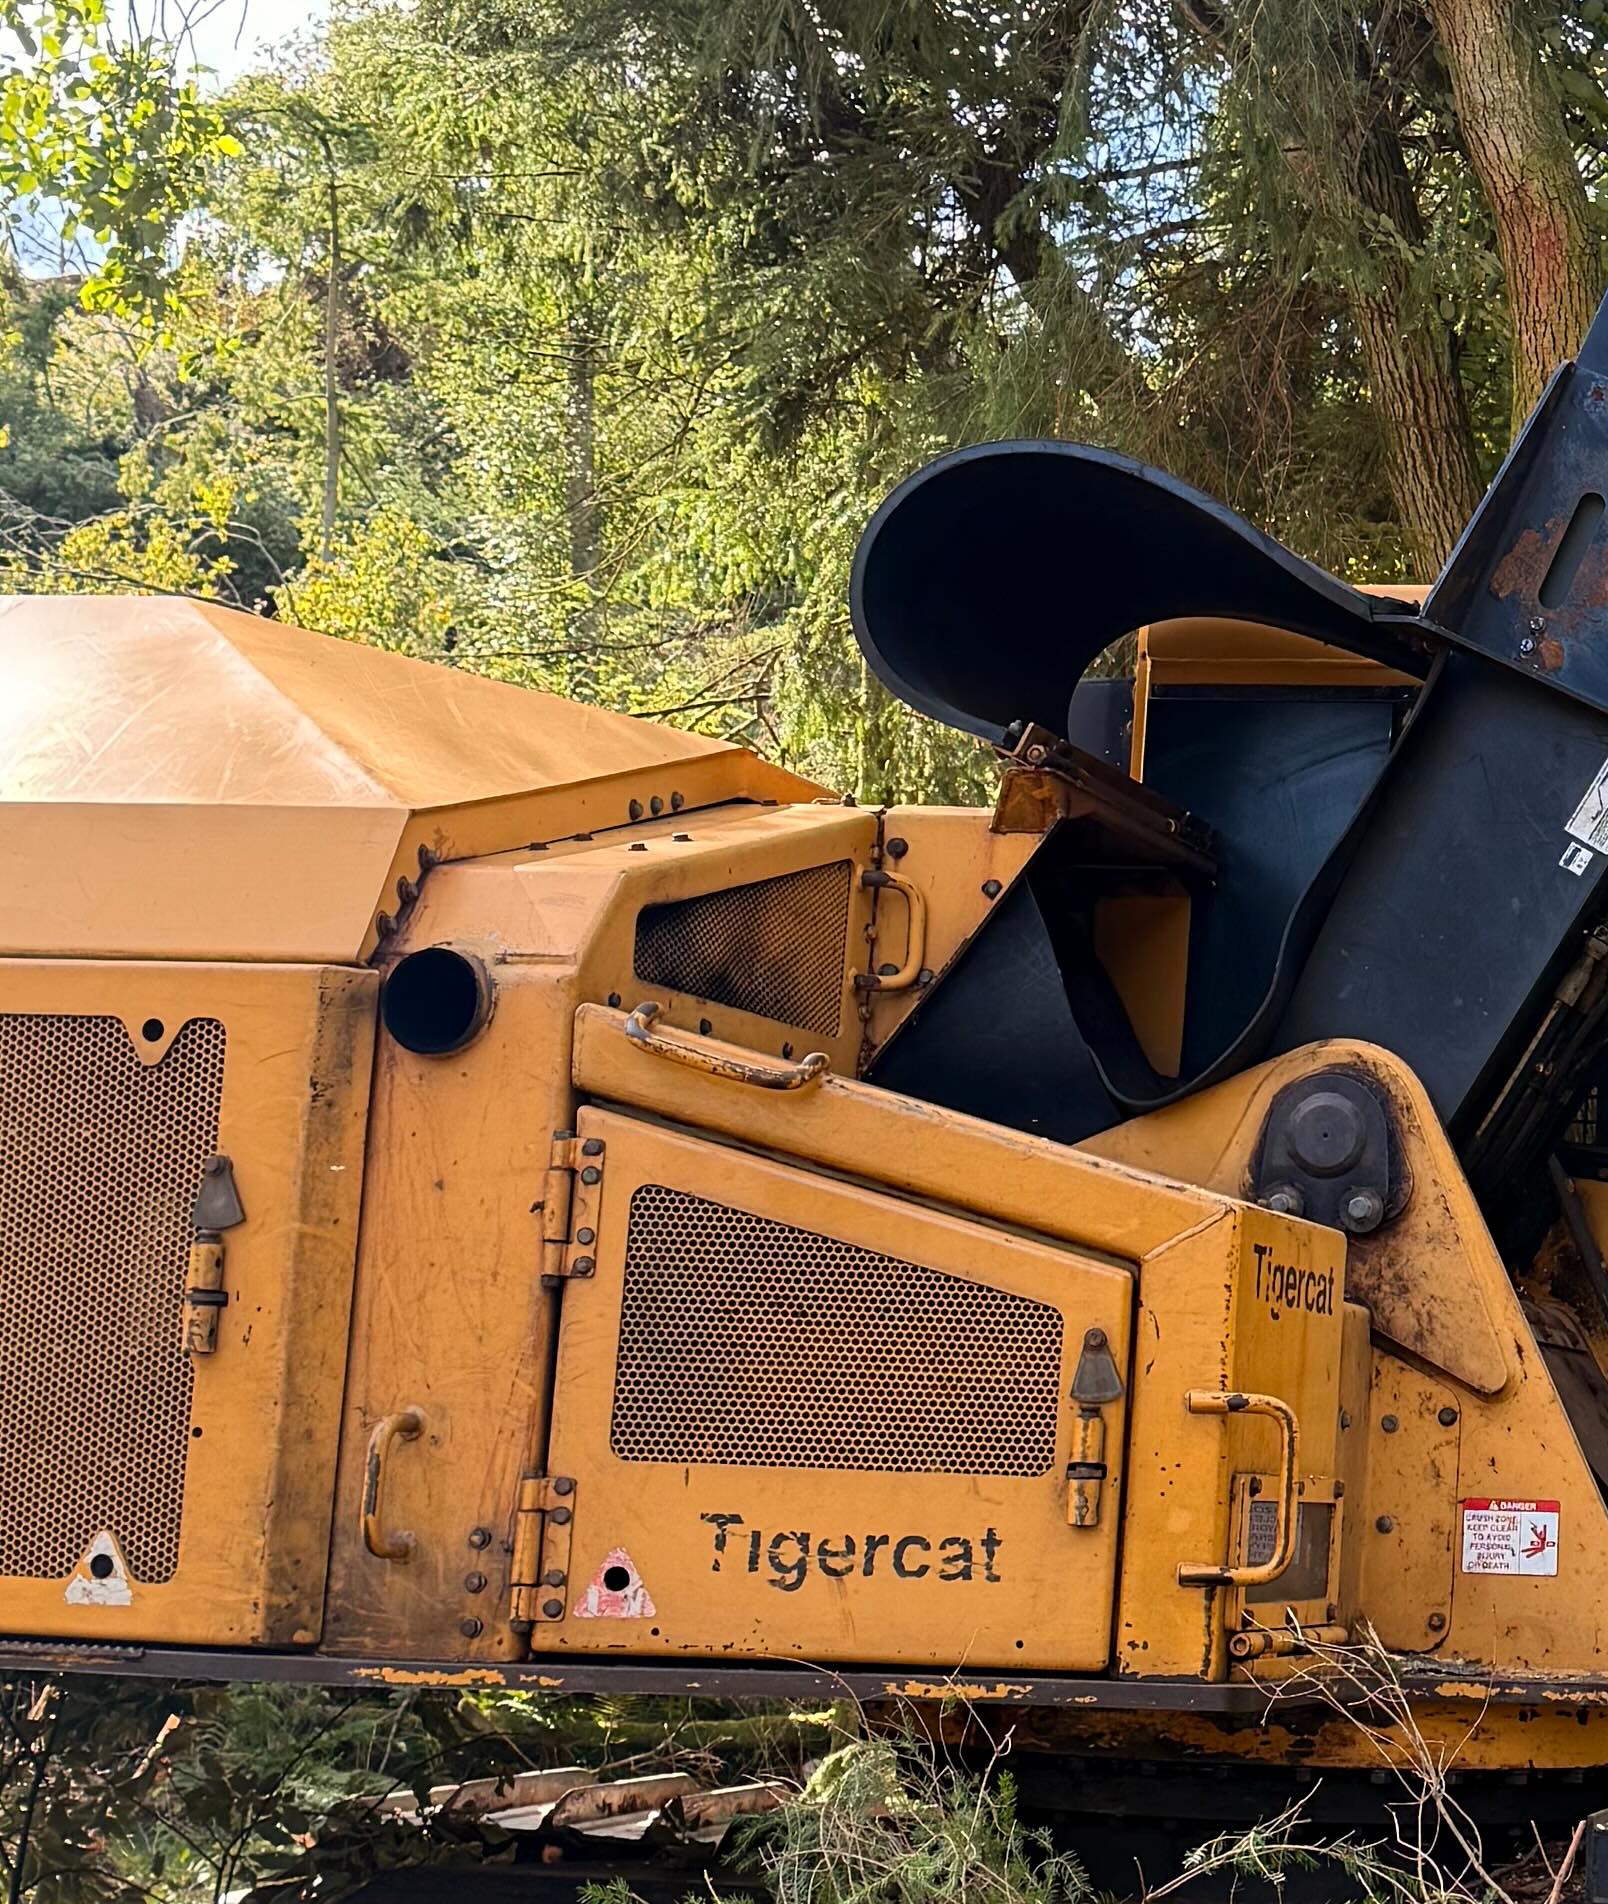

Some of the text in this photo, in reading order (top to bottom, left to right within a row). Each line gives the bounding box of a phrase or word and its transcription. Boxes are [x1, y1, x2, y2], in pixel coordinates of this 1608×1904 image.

[1253, 1243, 1335, 1322] Tigercat
[1499, 1501, 1537, 1511] DANGER
[1465, 1514, 1494, 1522] CRUSH
[1490, 1524, 1518, 1532] CLEAR
[1472, 1533, 1511, 1542] TO AVOID
[700, 1512, 1003, 1593] Tigercat
[1476, 1552, 1505, 1561] INJURY
[1482, 1561, 1510, 1570] DEATH
